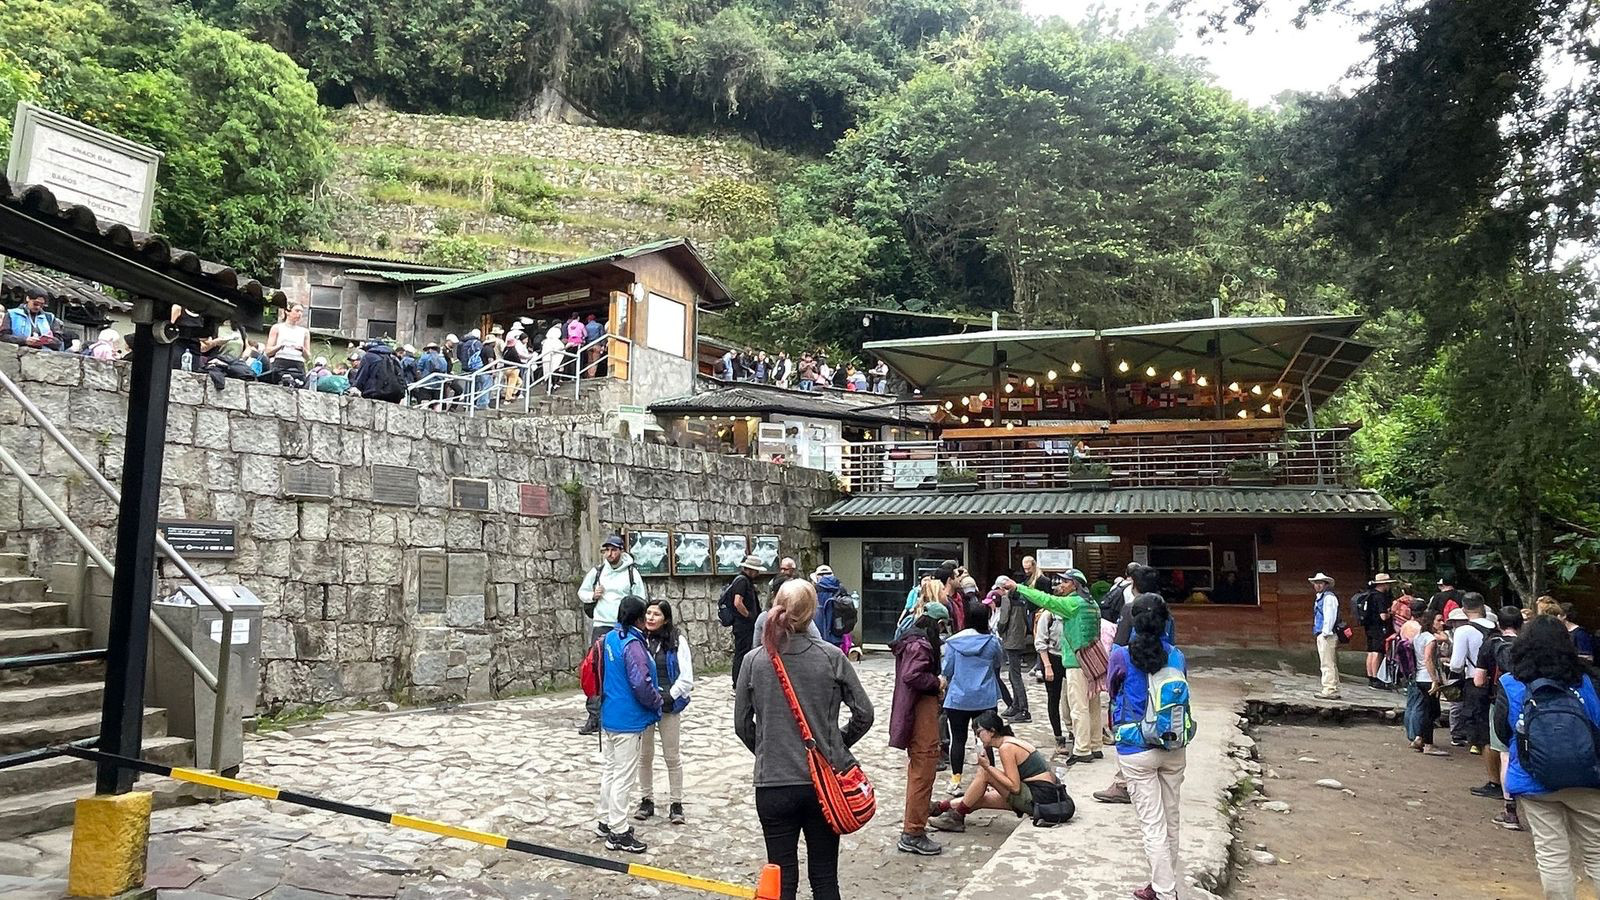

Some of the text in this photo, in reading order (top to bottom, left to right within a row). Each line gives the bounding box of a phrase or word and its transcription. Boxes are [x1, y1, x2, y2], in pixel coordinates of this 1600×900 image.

[72, 147, 112, 163] SNACK BAR
[51, 172, 77, 185] BAÑOS
[87, 199, 115, 213] TOILETS
[1408, 551, 1417, 563] 3
